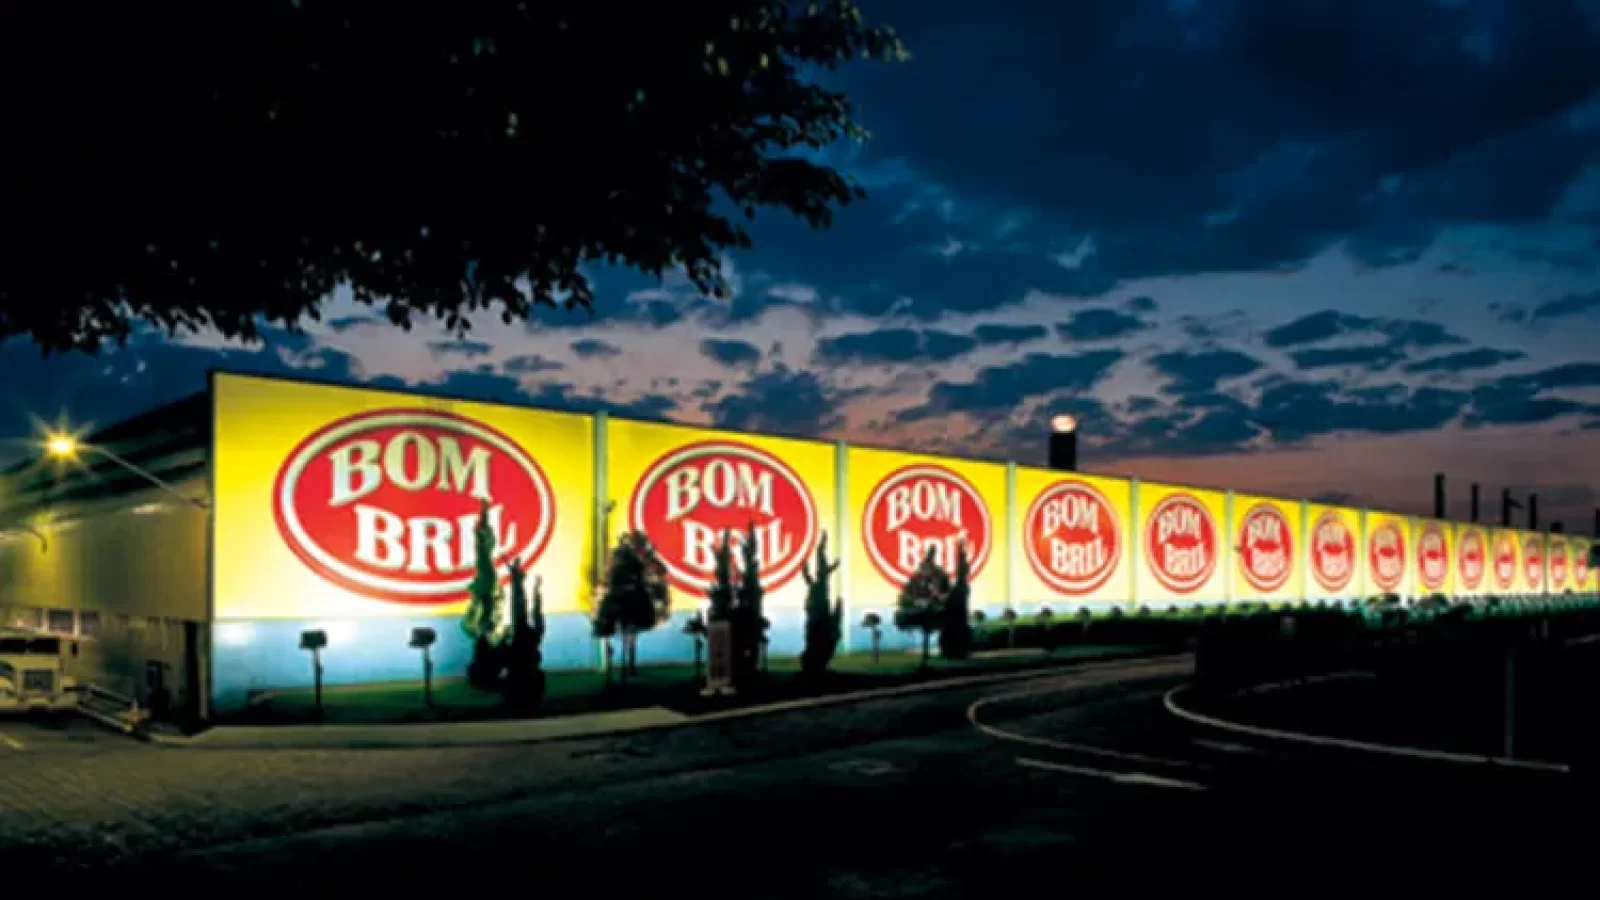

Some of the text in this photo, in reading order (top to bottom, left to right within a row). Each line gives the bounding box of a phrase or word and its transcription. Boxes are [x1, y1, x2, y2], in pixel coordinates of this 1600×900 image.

[328, 431, 492, 507] BOM
[665, 459, 774, 521] BOM
[886, 480, 962, 532] BOM
[1042, 495, 1099, 537] BOM
[353, 503, 517, 574] BRIL
[1051, 535, 1107, 576] BRIL
